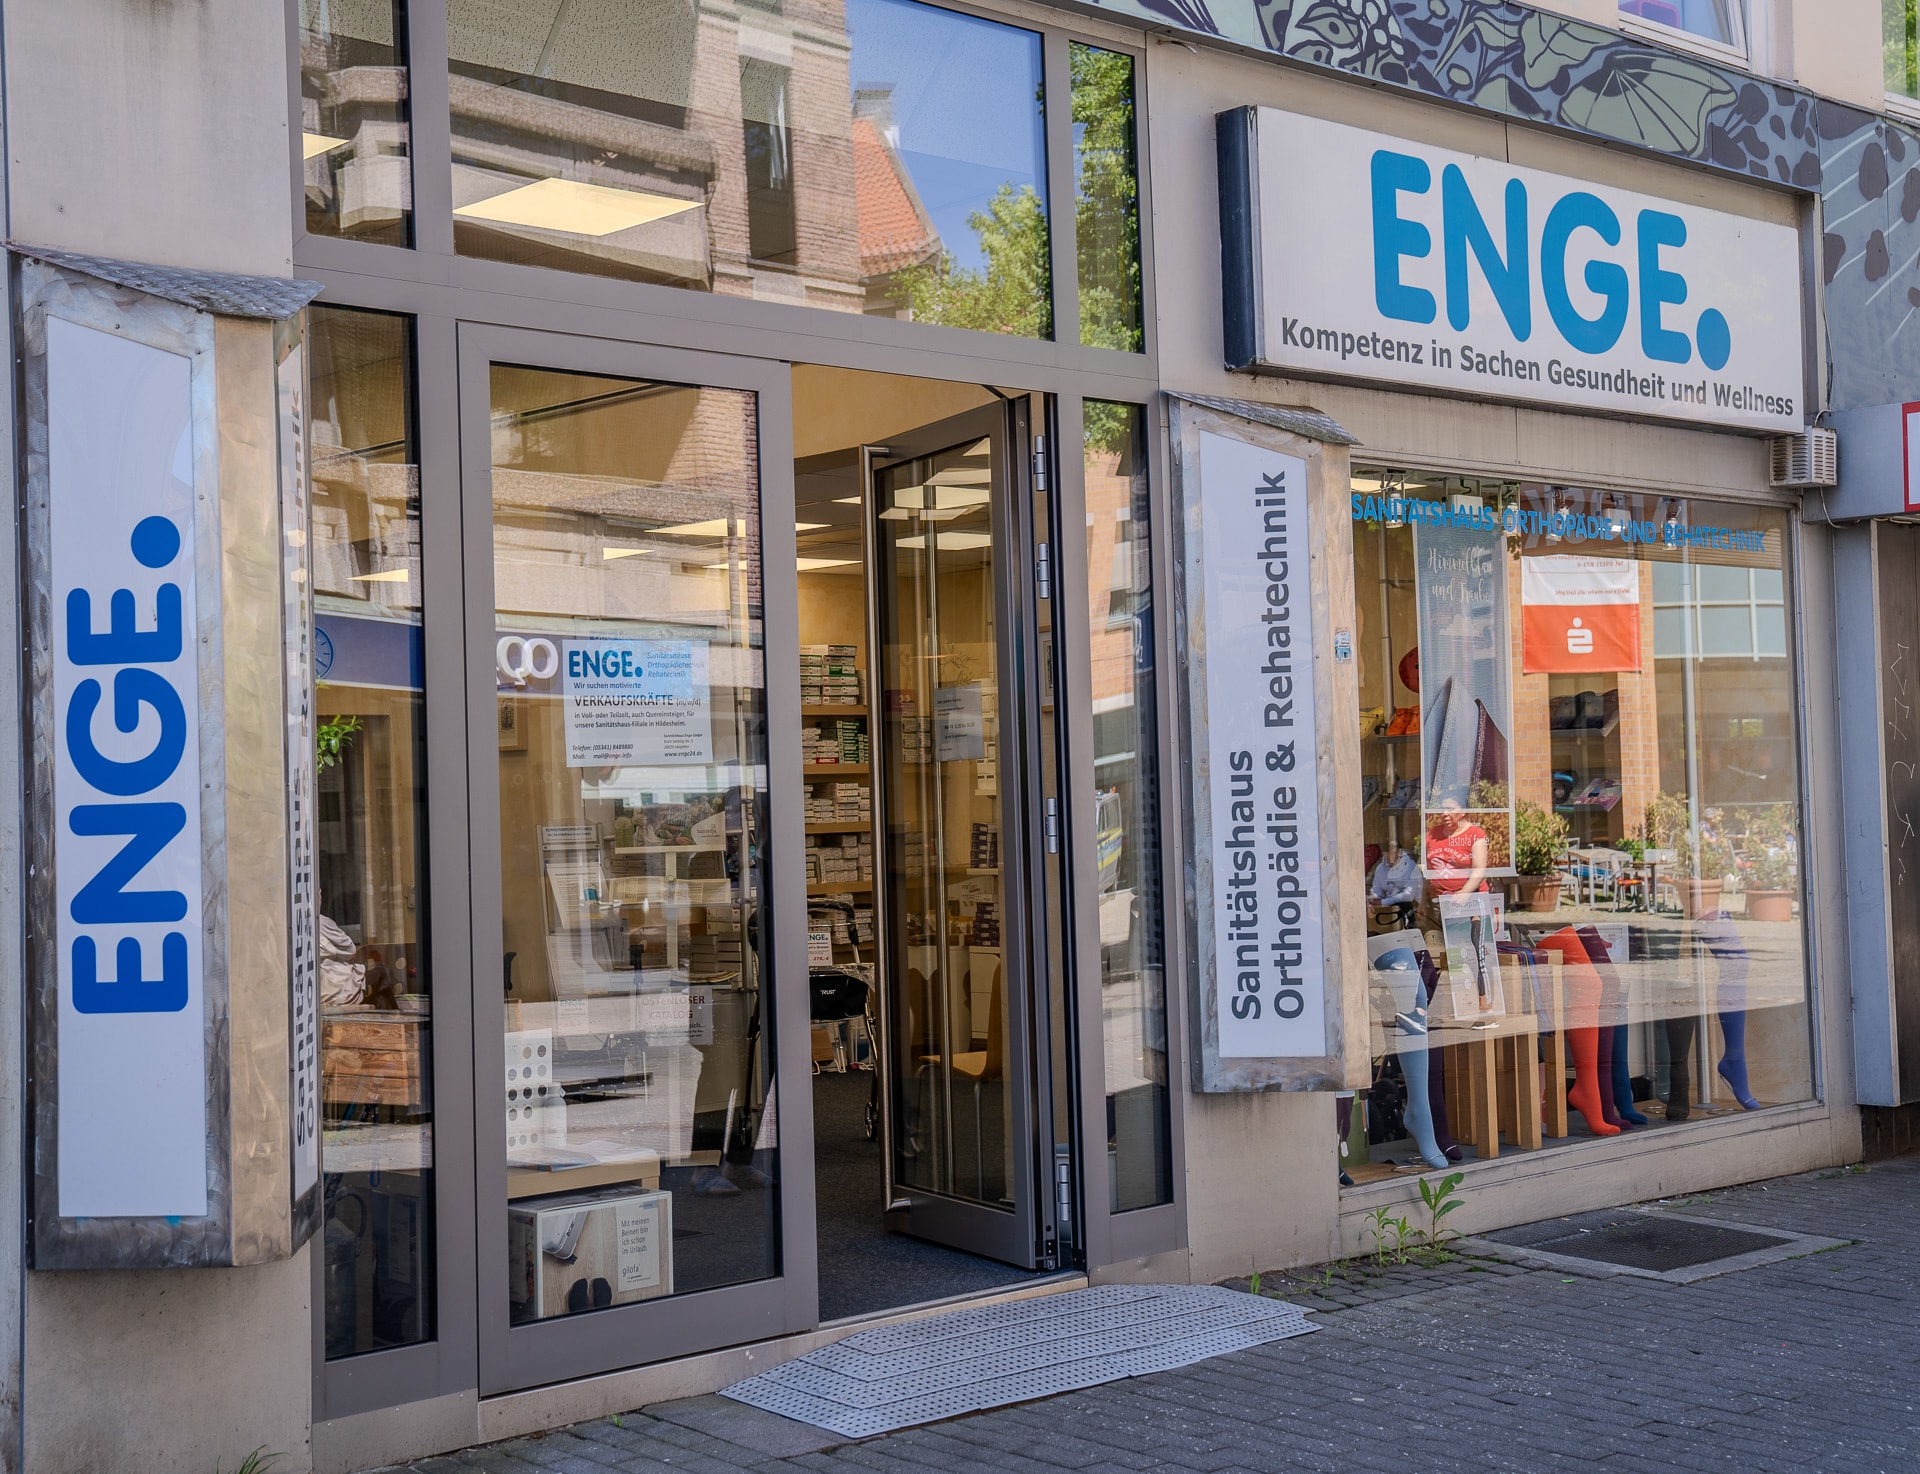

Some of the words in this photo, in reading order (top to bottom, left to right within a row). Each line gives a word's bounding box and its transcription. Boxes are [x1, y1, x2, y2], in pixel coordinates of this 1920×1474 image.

[1371, 150, 1731, 371] ENGE.
[1282, 317, 1423, 364] Kompetenz
[1431, 339, 1452, 368] in
[1460, 345, 1540, 381] Sachen
[1547, 359, 1665, 399] Gesundheit
[1672, 380, 1707, 405] und
[1713, 383, 1793, 416] Wellness
[1350, 494, 1494, 531] SANITÄTSHAUS
[1502, 508, 1613, 541] ORTHOPÄDIE
[1620, 519, 1657, 544] UND
[1664, 524, 1766, 553] REHATECHNIK
[1255, 470, 1294, 727] Rehatechnik
[1432, 577, 1455, 600] und
[568, 650, 643, 678] ENGE.
[574, 693, 673, 707] VERKAUFSKRÄFTE
[595, 719, 648, 728] Sanitätshaus-Filiale
[649, 719, 654, 727] in
[655, 719, 687, 728] Hildesheim.
[610, 710, 631, 719] Teilzeit,
[632, 710, 644, 718] auch
[645, 710, 686, 719] Quereinsteiger,
[687, 710, 695, 718] für
[66, 516, 188, 1013] ENGE.
[1265, 739, 1295, 773] &
[1225, 750, 1261, 1019] Sanitätshaus
[1266, 786, 1307, 1019] Orthopädie
[642, 995, 705, 1006] OSTENLOSER
[621, 1228, 639, 1237] Beinen
[640, 1226, 648, 1234] bin
[631, 1217, 650, 1226] meinen
[621, 1238, 630, 1246] ich
[630, 1236, 646, 1245] schon
[622, 1247, 628, 1255] im
[629, 1245, 648, 1254] Urlaub.
